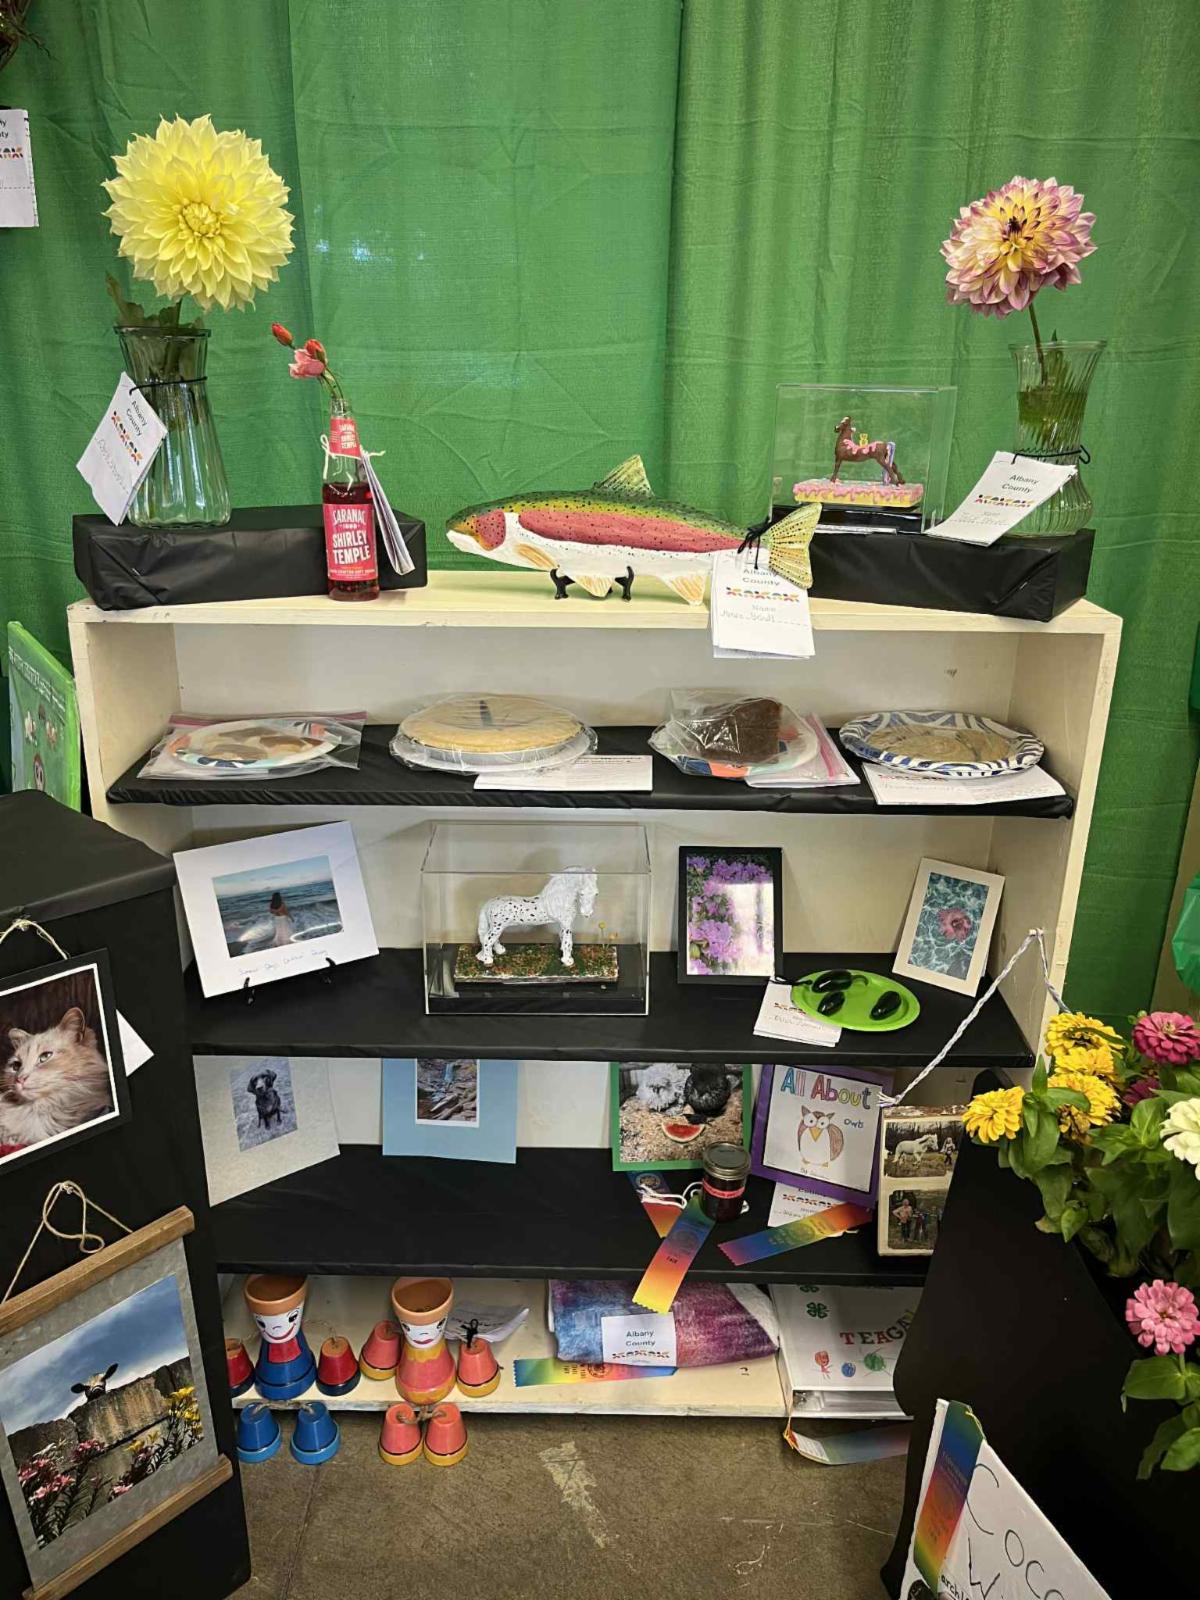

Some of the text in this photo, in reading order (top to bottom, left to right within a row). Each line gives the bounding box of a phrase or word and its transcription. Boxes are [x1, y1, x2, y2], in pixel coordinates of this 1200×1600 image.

[126, 408, 143, 437] County
[131, 400, 148, 427] Albany
[1009, 474, 1040, 484] Albany
[1001, 483, 1033, 494] County
[333, 508, 367, 526] SARANAC
[332, 530, 368, 549] SHIRLEY
[333, 545, 372, 565] TEMPLE
[742, 577, 780, 587] County
[781, 1067, 872, 1110] All About
[626, 1329, 655, 1340] Albany
[625, 1340, 656, 1348] County
